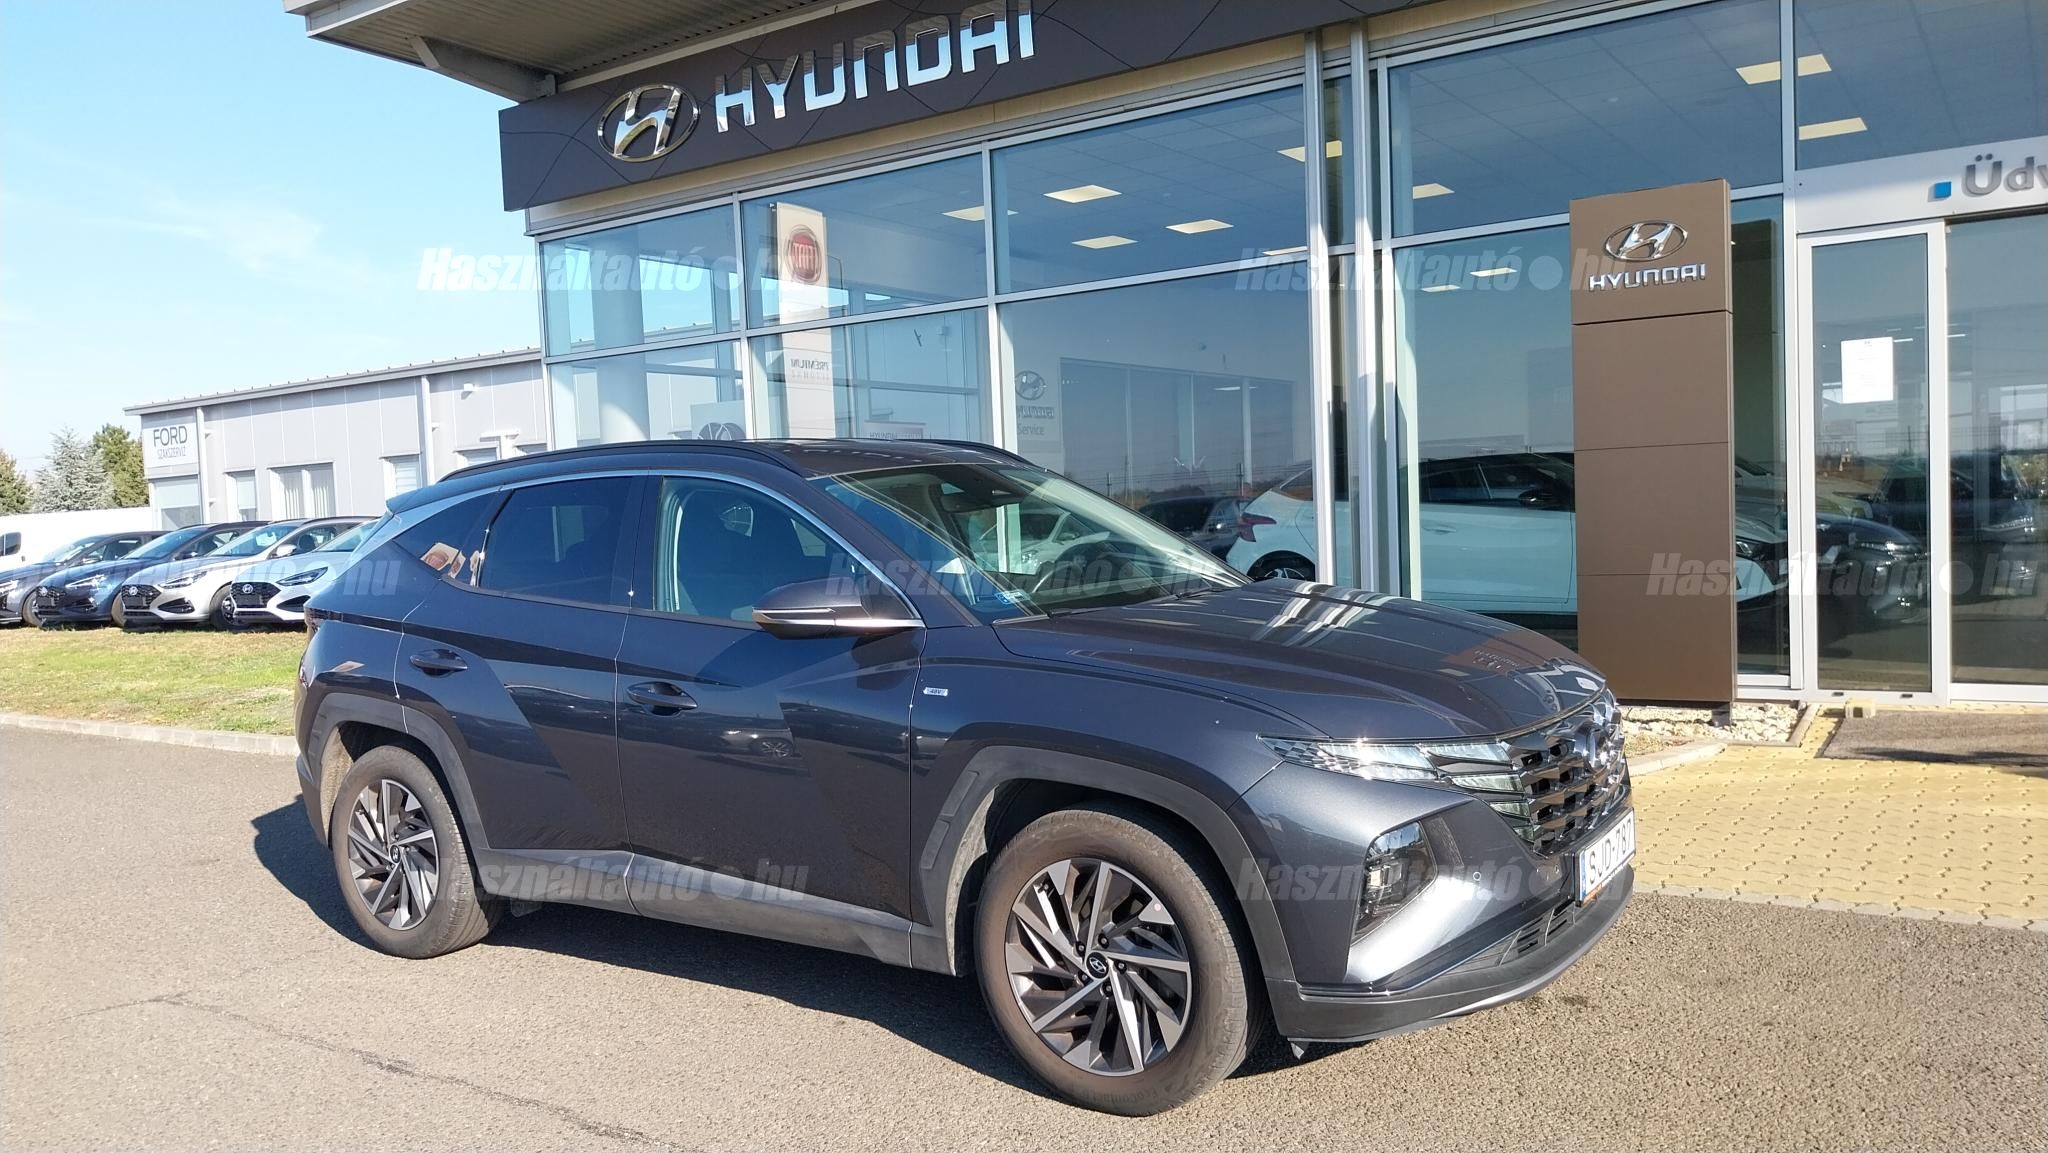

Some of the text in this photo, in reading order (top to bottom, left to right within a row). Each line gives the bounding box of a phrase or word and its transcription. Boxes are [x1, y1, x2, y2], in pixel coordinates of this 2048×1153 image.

[715, 0, 1034, 132] HYUNDAI
[1588, 263, 1706, 292] HYUNDAI
[153, 425, 188, 447] FORD
[1588, 817, 1632, 886] SJD-787
